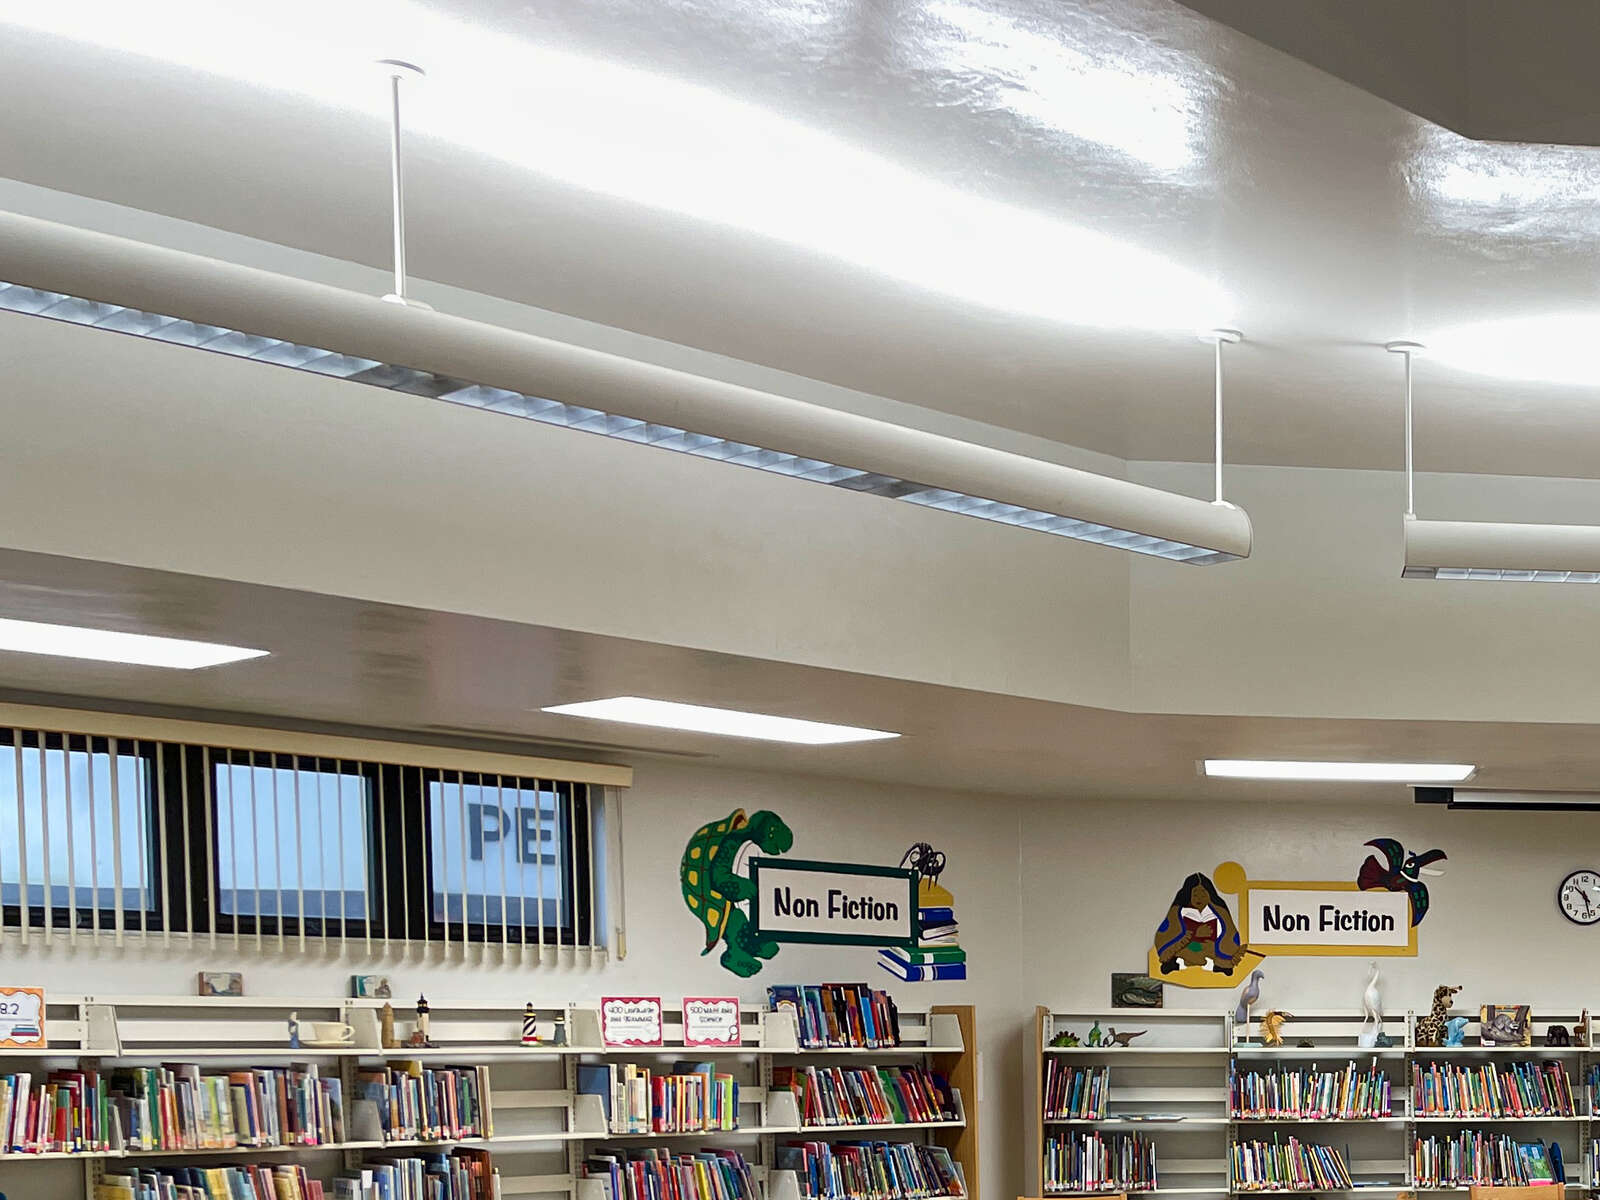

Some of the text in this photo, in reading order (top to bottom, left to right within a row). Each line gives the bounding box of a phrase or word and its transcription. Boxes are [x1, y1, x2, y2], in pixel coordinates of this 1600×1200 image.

[468, 803, 556, 865] PE
[1581, 875, 1589, 883] 12
[774, 887, 898, 921] Non Fiction
[1263, 904, 1395, 932] Non Fiction
[690, 1006, 702, 1014] 500
